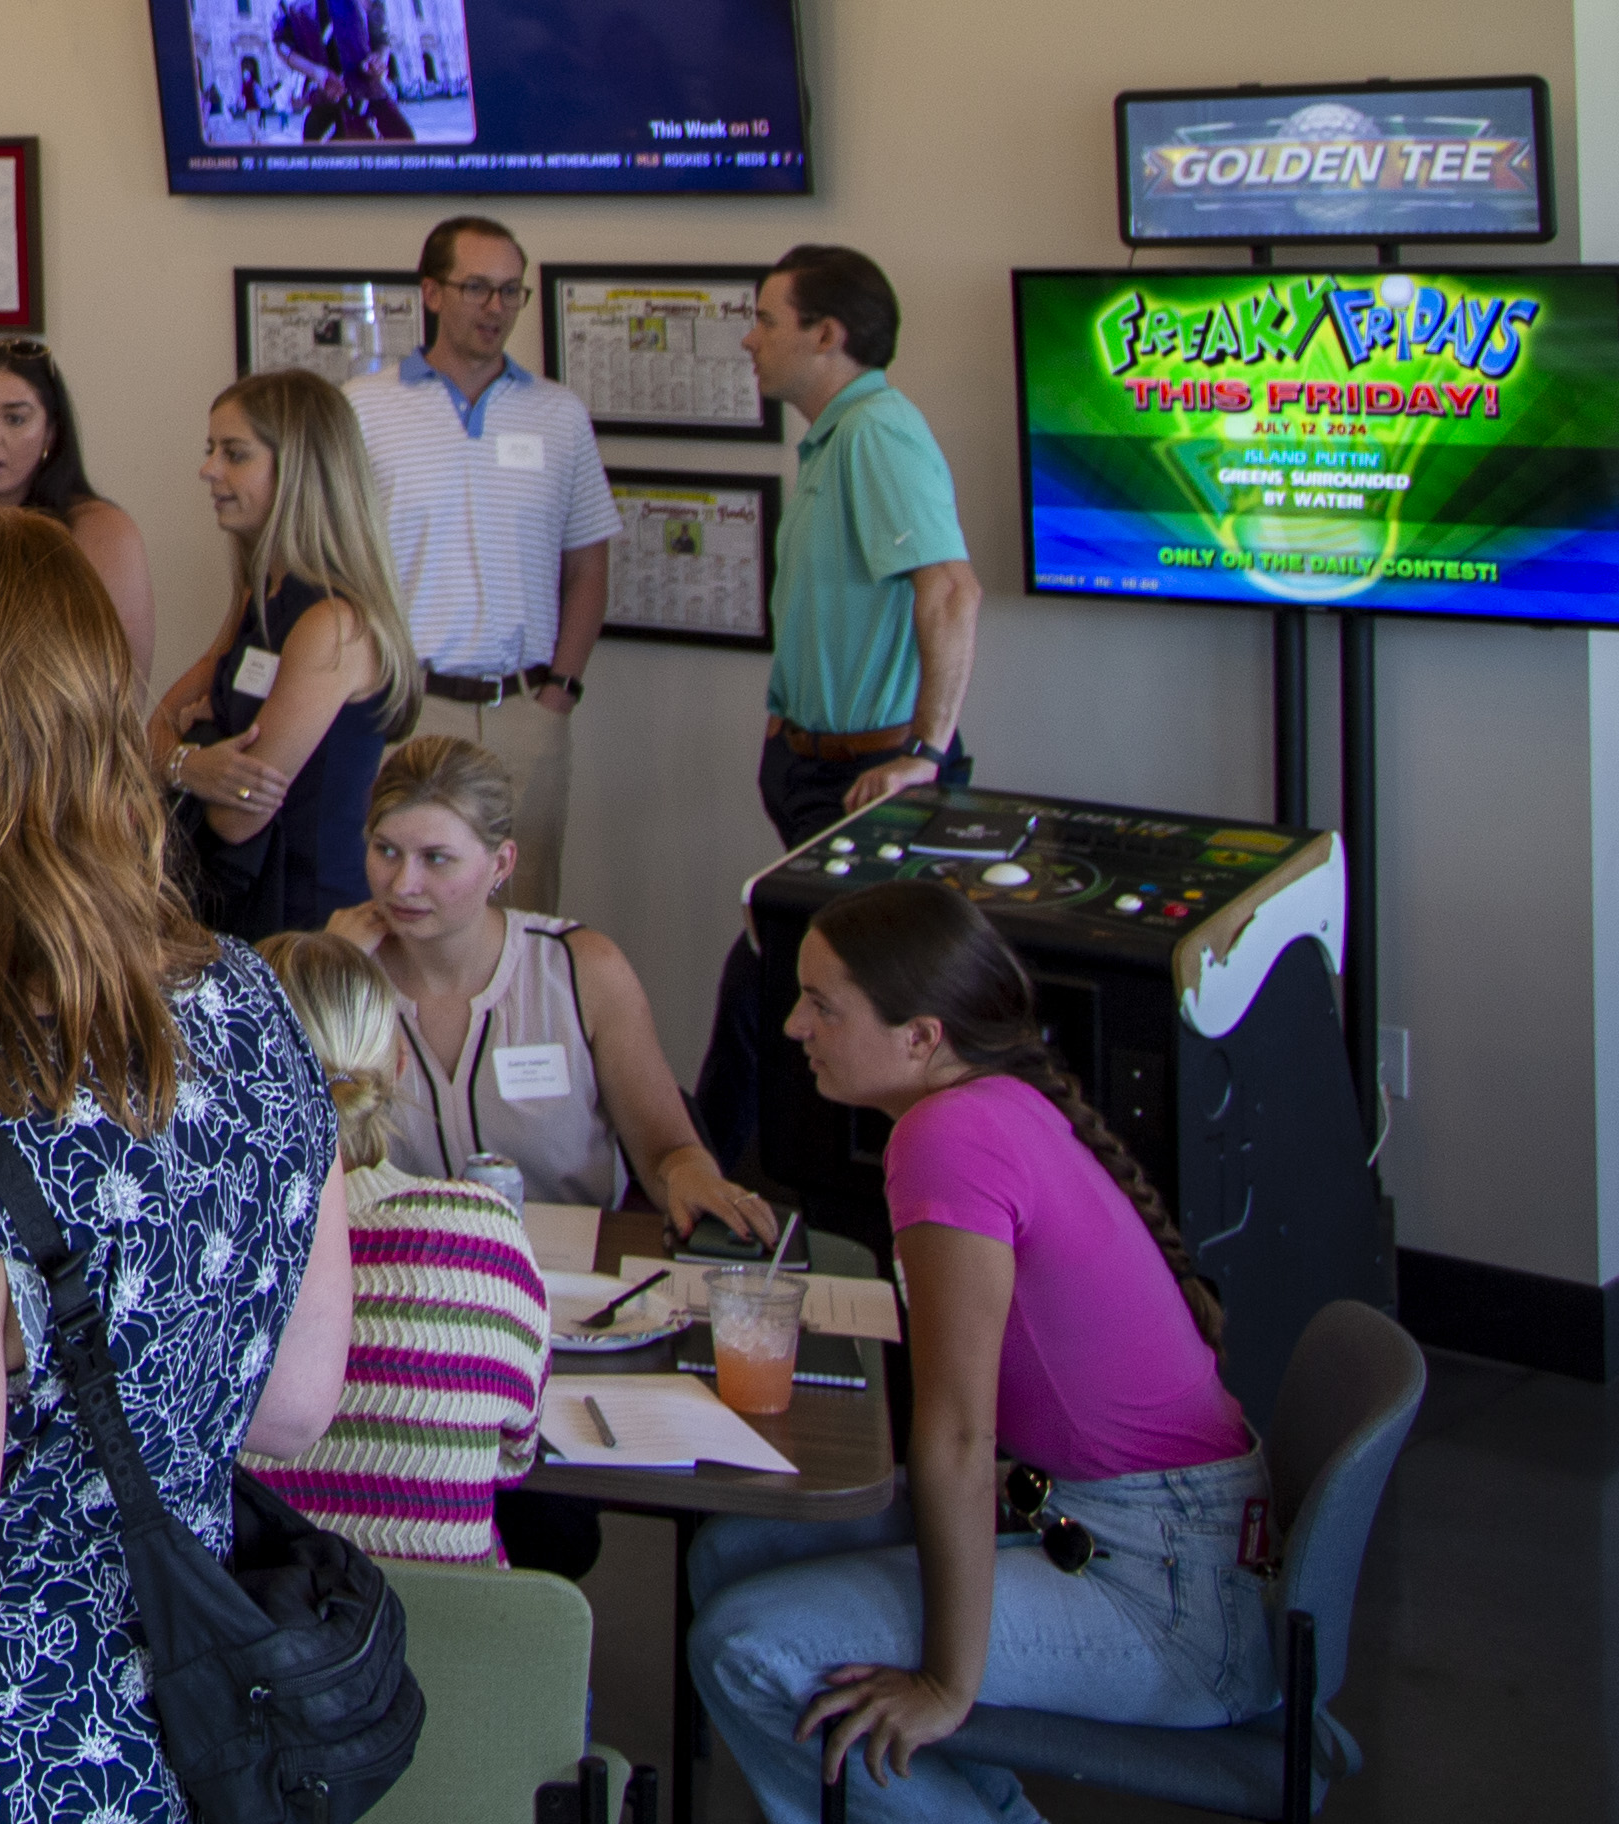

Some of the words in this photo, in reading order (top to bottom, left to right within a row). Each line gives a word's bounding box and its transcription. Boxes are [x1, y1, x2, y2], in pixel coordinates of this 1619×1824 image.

[649, 119, 683, 139] This
[684, 118, 727, 139] Week
[728, 122, 750, 137] on
[663, 152, 711, 168] ROCKIES
[735, 151, 768, 167] REDS
[1172, 144, 1387, 188] GOLDEN
[1401, 143, 1498, 182] TEE
[1097, 277, 1339, 375] FREAKY
[1328, 276, 1540, 378] FRIDAYS
[1124, 379, 1253, 413] THIS
[1266, 381, 1501, 420] FRIDAY!
[1253, 421, 1291, 434] JULY
[1301, 422, 1316, 434] 12
[1327, 422, 1367, 435] 2024
[1244, 449, 1308, 465] ISLAND
[1218, 467, 1284, 485] GREENS
[1290, 469, 1411, 490] SURROUNDED
[1263, 490, 1286, 507] BY
[1293, 492, 1365, 509] WATER!
[1158, 546, 1216, 568] ONLY
[1220, 550, 1255, 571] ON
[1260, 552, 1306, 573] THE
[1311, 554, 1374, 577] DAILY
[1381, 557, 1500, 583] CONTEST!
